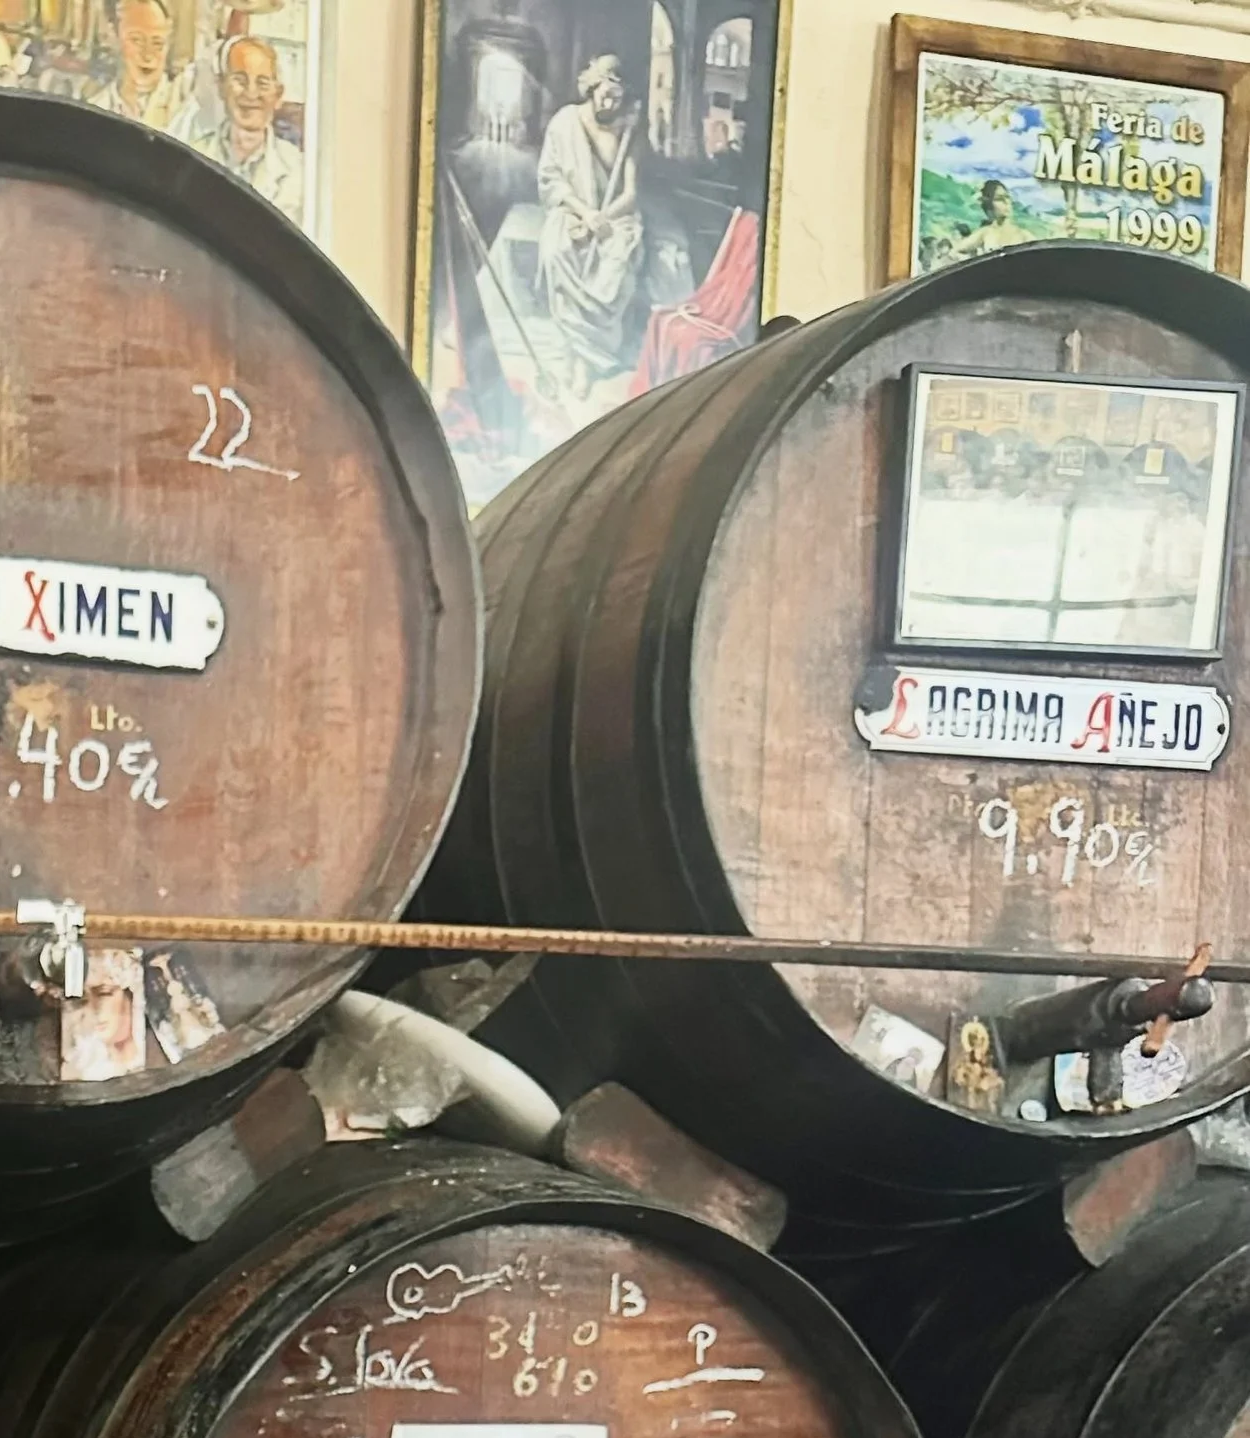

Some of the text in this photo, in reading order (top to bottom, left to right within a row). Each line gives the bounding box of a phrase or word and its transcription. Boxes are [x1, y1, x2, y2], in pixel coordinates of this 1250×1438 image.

[1091, 103, 1205, 145] Feria de
[1034, 133, 1203, 205] Málaga
[1105, 206, 1203, 254] 1999
[187, 383, 300, 481] 22
[23, 571, 175, 644] XIMEN
[90, 704, 143, 733] Lto.
[879, 677, 1202, 754] LAGRIMA AÑEJO
